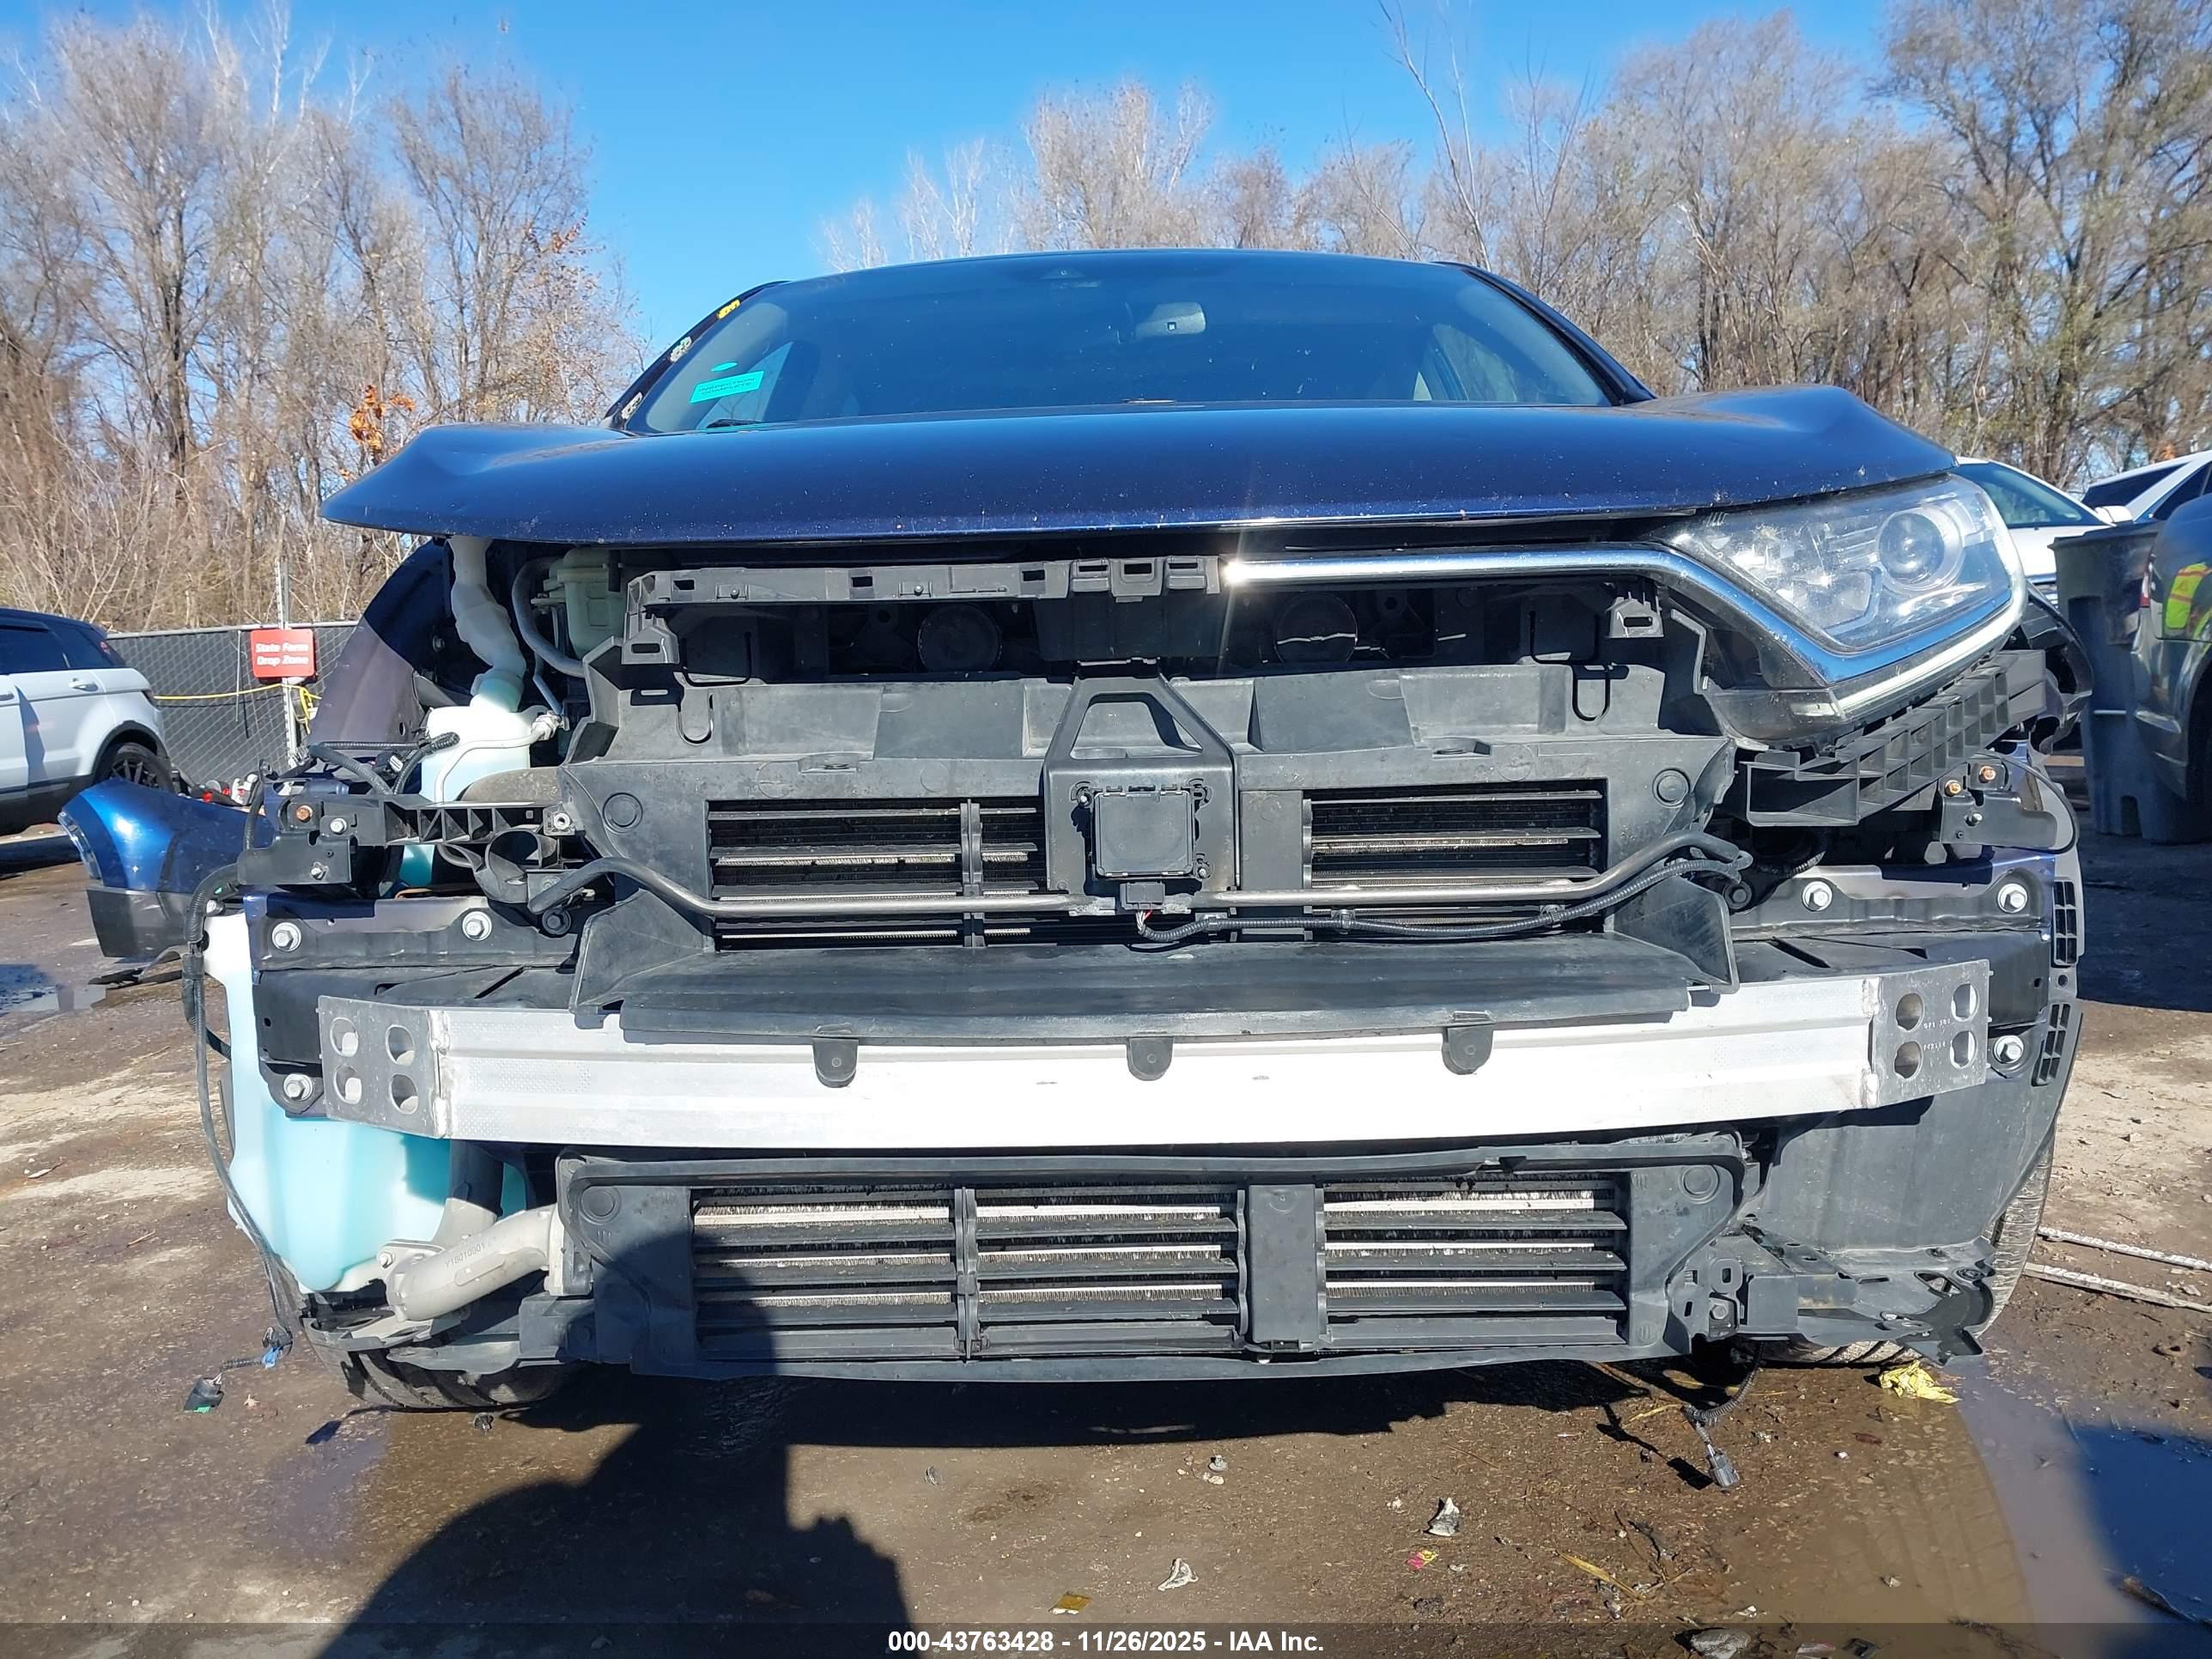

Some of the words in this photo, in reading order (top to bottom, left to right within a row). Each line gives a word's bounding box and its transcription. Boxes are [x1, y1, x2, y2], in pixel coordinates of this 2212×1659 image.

[255, 643, 281, 653] State
[282, 642, 309, 652] Farm
[256, 655, 281, 667] Drop
[282, 654, 309, 665] Zone
[2039, 1226, 2103, 1244] RYSLER
[2104, 1241, 2165, 1259] DODGE
[2165, 1255, 2209, 1267] JEEP
[2044, 1265, 2130, 1287] VICTORY
